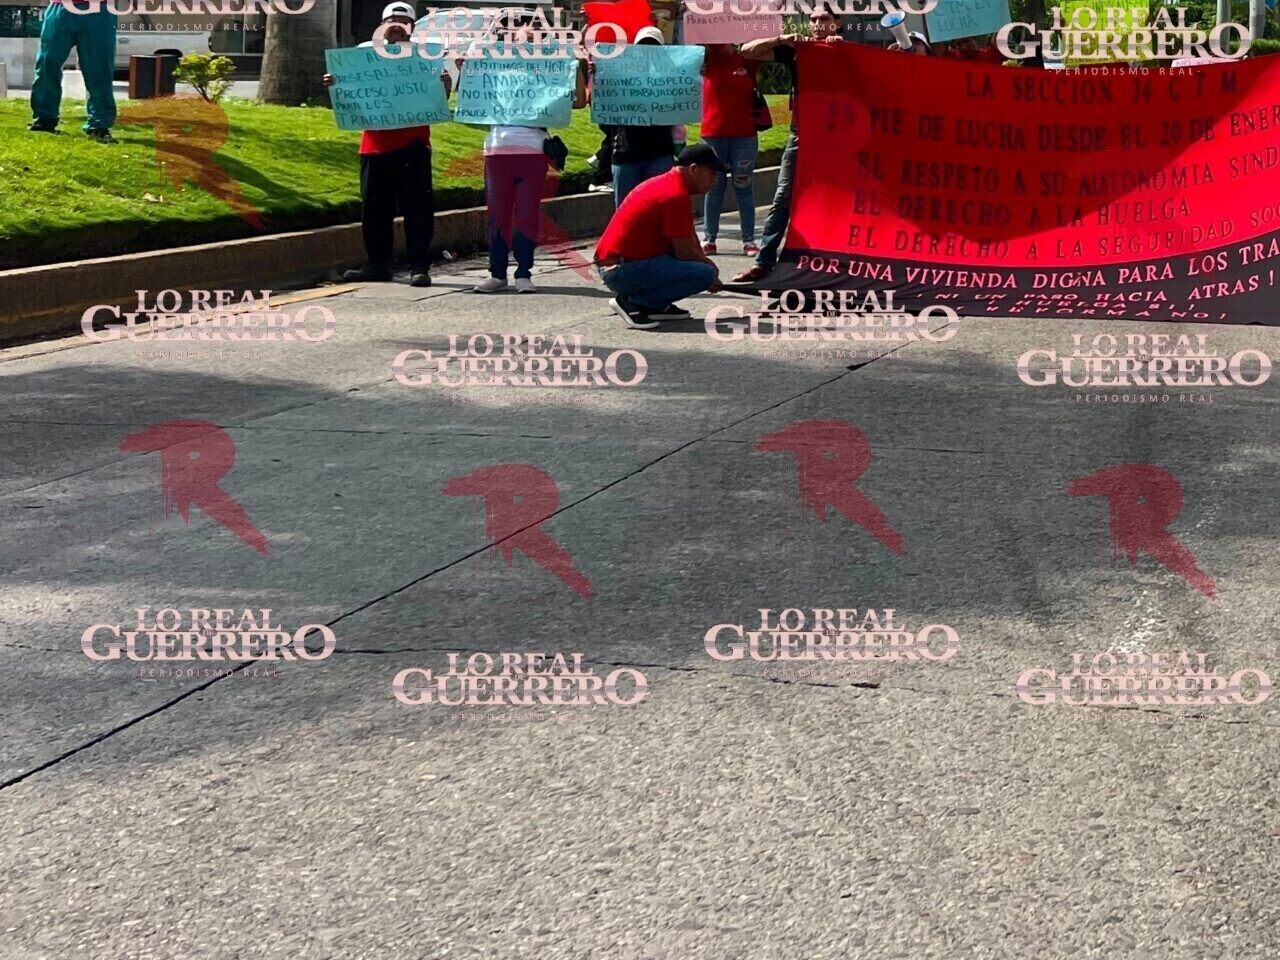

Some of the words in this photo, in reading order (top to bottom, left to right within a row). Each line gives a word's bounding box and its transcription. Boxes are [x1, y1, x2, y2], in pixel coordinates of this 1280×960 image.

[335, 85, 387, 100] PROCESO
[393, 82, 428, 97] JUSTO
[462, 88, 480, 99] NO
[966, 71, 995, 98] LA
[1012, 75, 1113, 104] SECCION
[870, 105, 904, 136] PIE
[918, 113, 945, 141] DE
[956, 118, 1025, 152] LUCHA
[1038, 124, 1106, 153] DESDE
[902, 158, 999, 192] RESPETO
[1014, 171, 1026, 195] A
[1040, 172, 1066, 197] SU
[1078, 165, 1215, 196] AUTONOMIA
[852, 188, 881, 217] EL
[900, 192, 1011, 228] DERECHO
[1028, 206, 1040, 228] A
[1056, 205, 1084, 228] LA
[1097, 197, 1190, 226] HUELGA
[848, 224, 877, 249] EL
[894, 229, 1009, 260] DERECHO
[1025, 240, 1039, 261] A
[1056, 239, 1084, 259] LA
[1098, 219, 1234, 258] SEGURIDAD
[796, 255, 840, 274] POR
[848, 259, 894, 282] UNA
[905, 266, 1018, 289] VIVIENDA
[1032, 269, 1106, 289] DIGNA
[1118, 262, 1174, 284] PARA
[1188, 251, 1228, 276] LOS
[1096, 291, 1167, 302] HACIA
[1187, 275, 1259, 300] ATRAS
